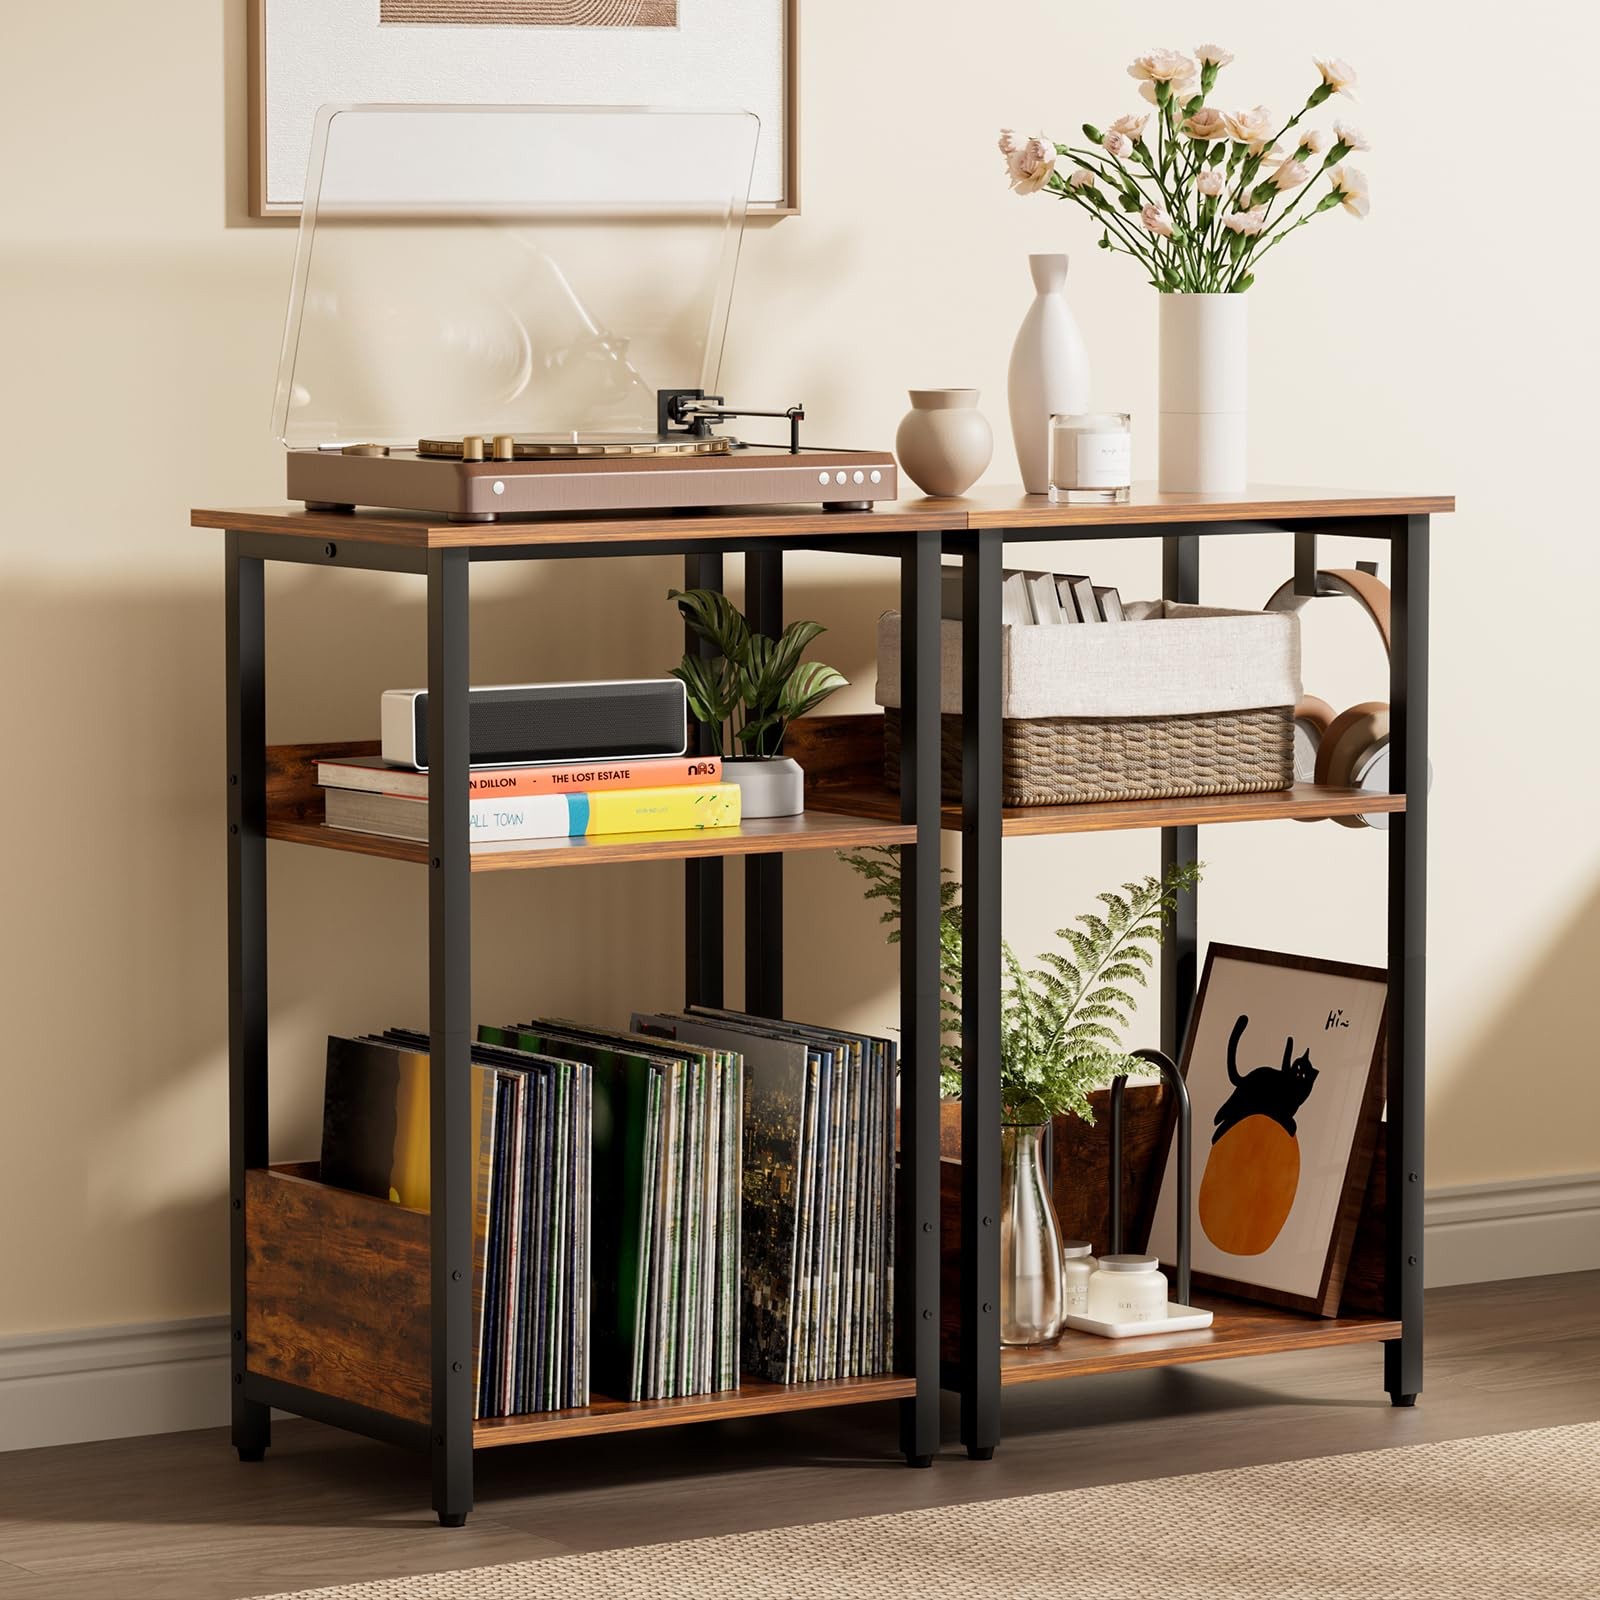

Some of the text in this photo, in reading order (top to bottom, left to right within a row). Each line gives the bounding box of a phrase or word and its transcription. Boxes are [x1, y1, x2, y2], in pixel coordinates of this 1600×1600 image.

[480, 778, 517, 789] DILLON
[552, 774, 569, 783] THE
[572, 772, 595, 782] LOST
[598, 770, 630, 780] ESTATE
[493, 812, 524, 827] TOWN
